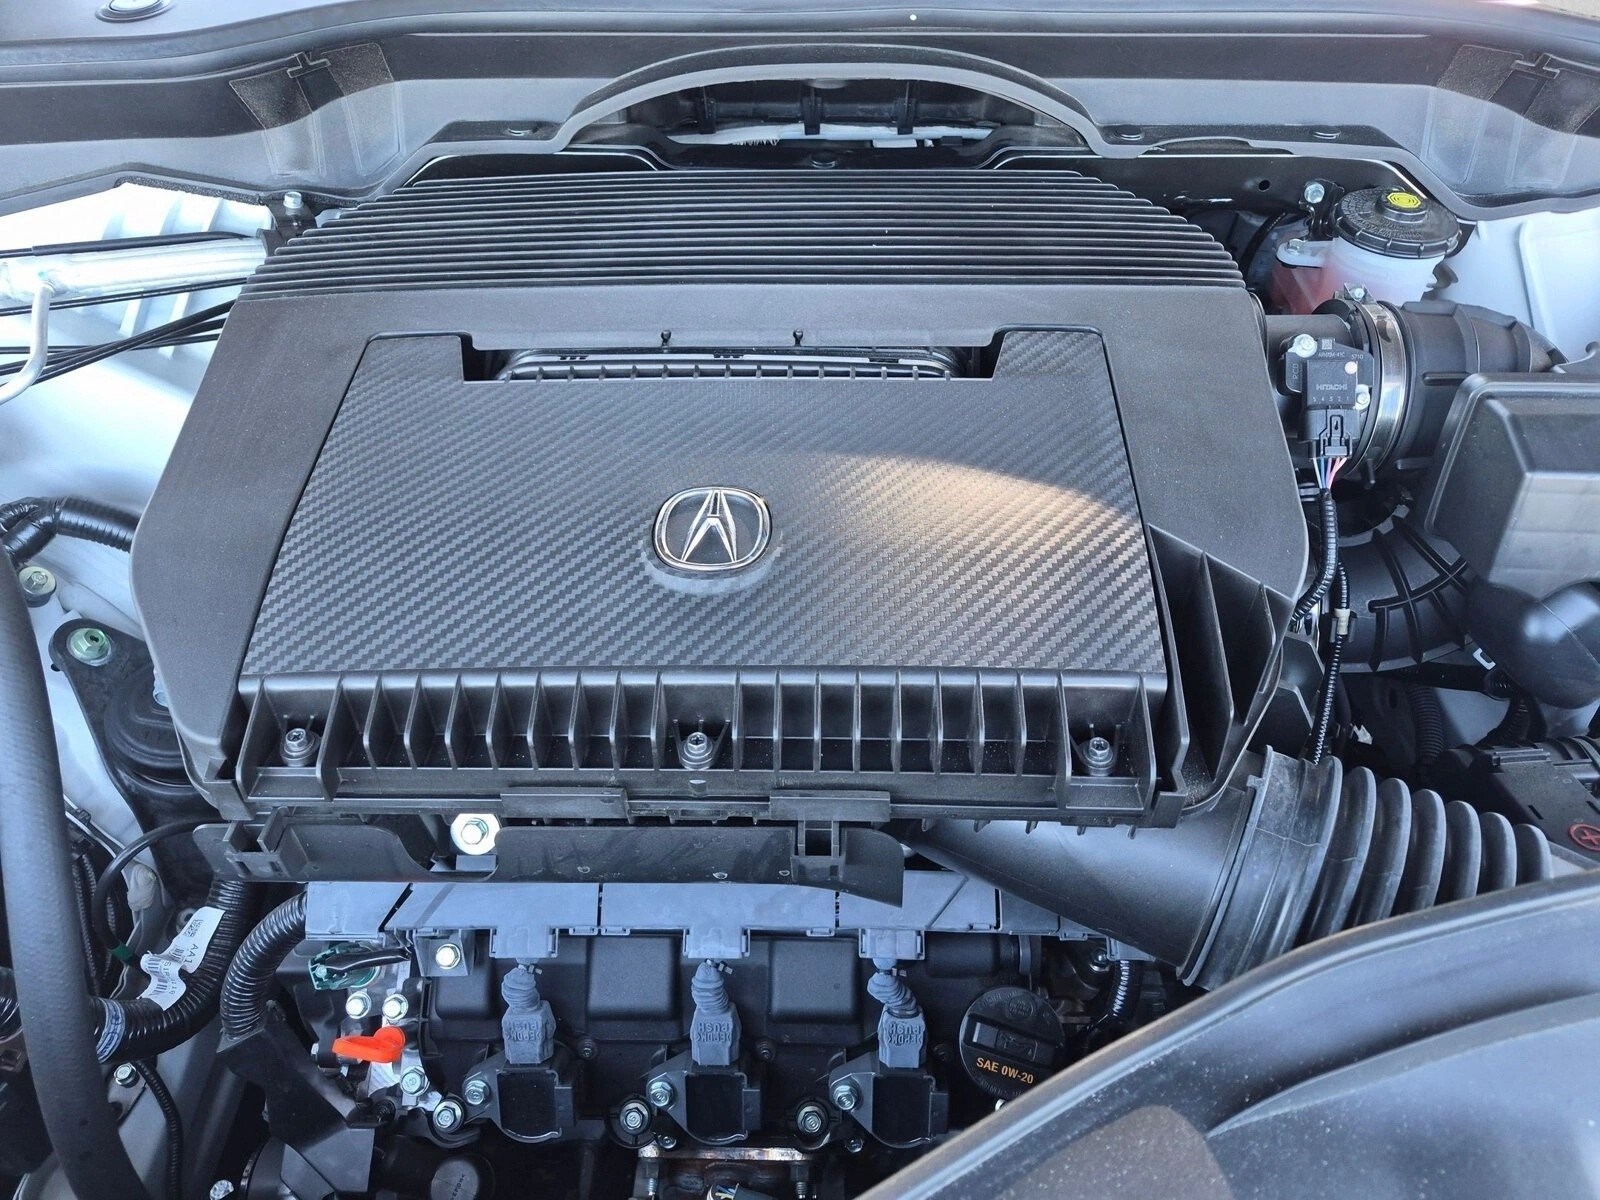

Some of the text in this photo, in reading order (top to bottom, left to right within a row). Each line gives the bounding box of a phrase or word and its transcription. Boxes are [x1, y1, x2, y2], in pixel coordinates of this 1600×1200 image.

[183, 943, 199, 964] AA1
[698, 1020, 731, 1032] PUSH
[889, 1021, 921, 1034] PUSH
[976, 1057, 1034, 1084] SAE 0W-20
